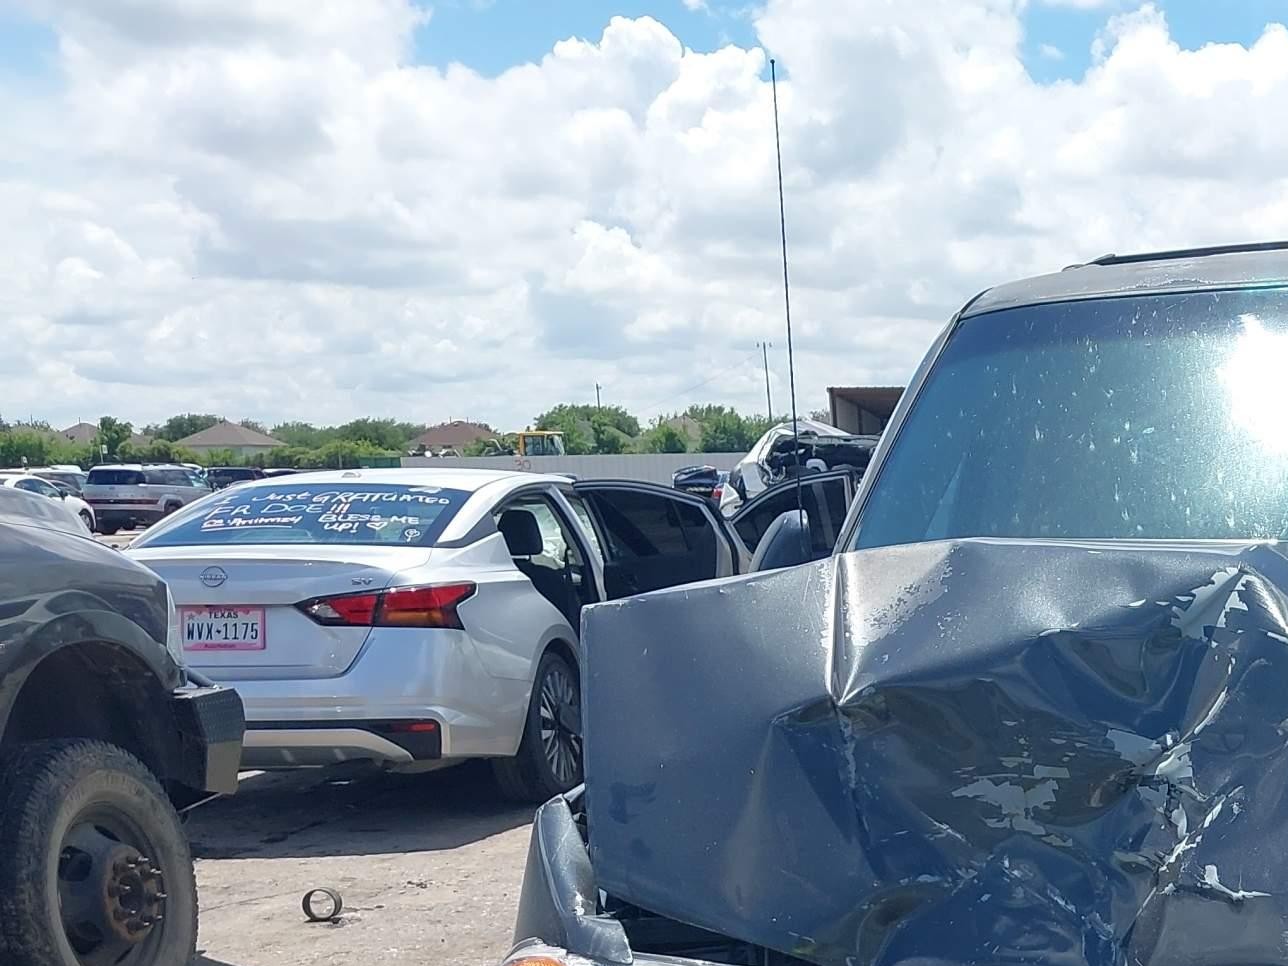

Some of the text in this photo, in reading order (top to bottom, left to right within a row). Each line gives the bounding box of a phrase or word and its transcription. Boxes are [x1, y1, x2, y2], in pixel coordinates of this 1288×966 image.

[390, 516, 420, 525] ME
[352, 577, 373, 586] SV
[208, 611, 239, 619] TEXAS
